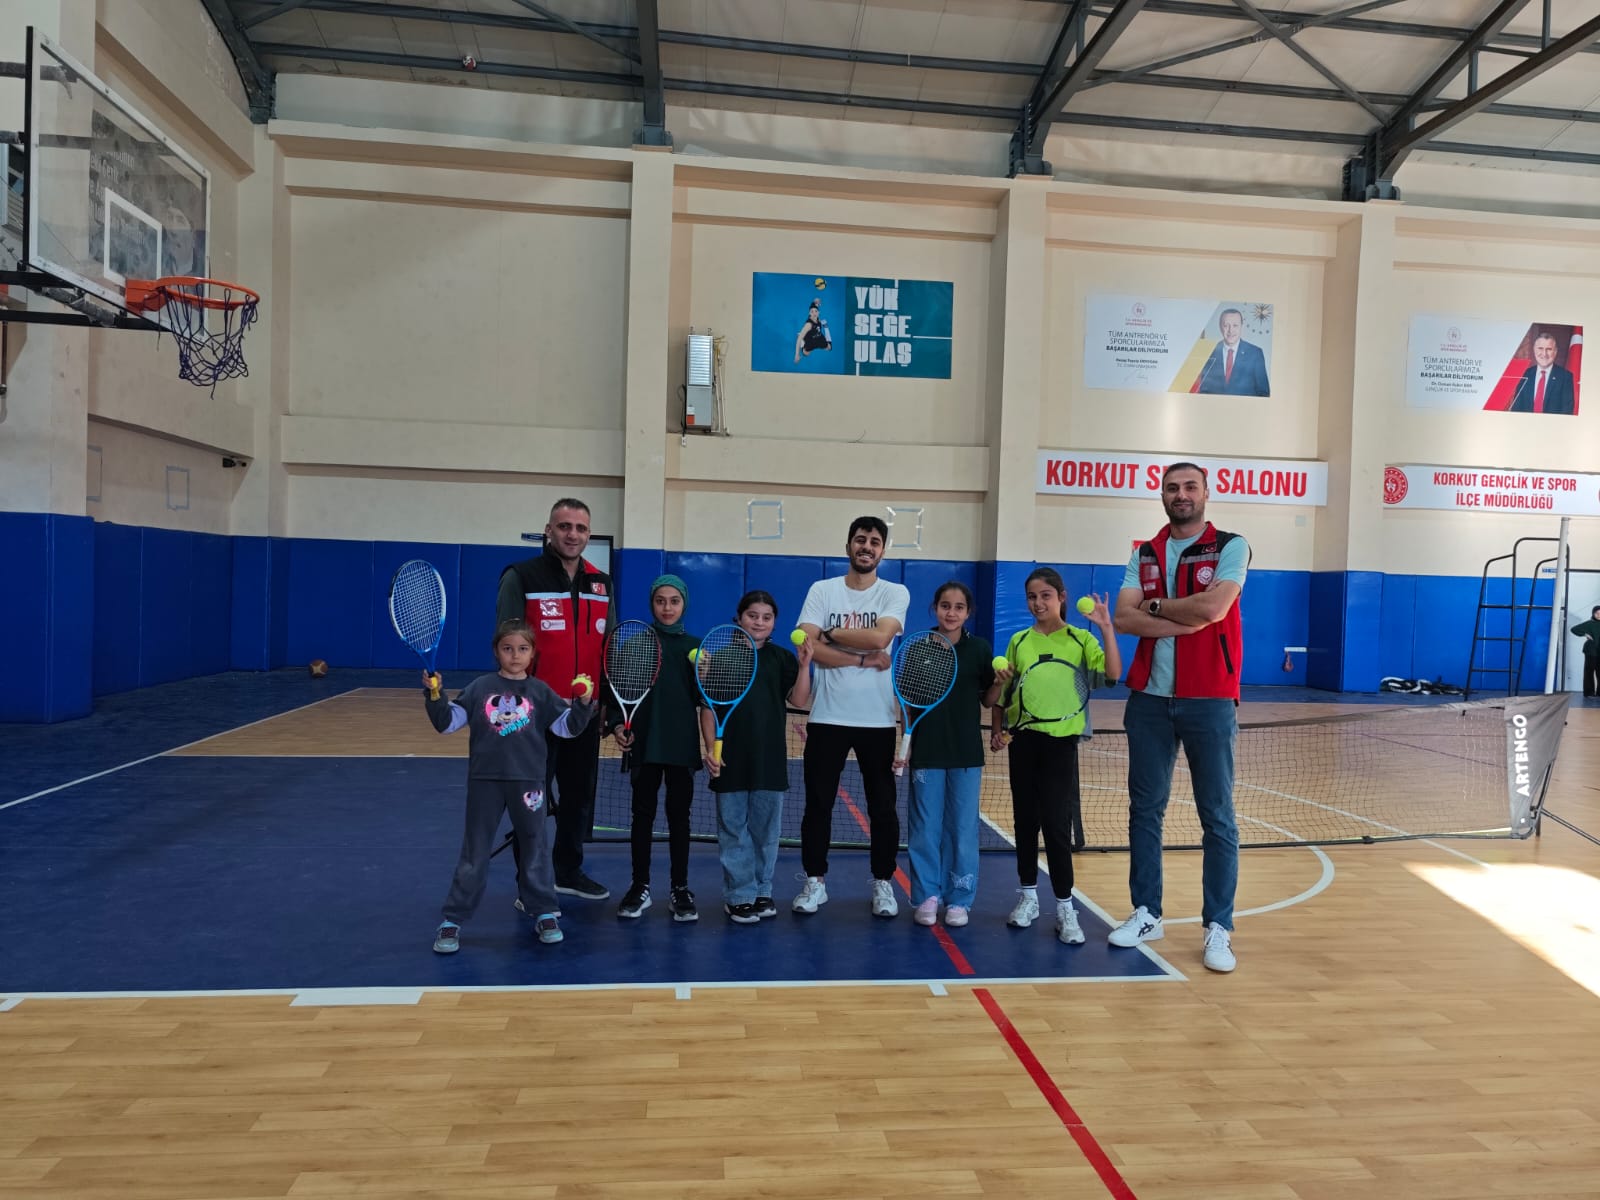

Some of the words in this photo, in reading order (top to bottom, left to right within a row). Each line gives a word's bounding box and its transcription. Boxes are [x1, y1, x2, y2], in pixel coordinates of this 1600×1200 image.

[854, 285, 898, 310] YÜK
[854, 312, 912, 338] SEĞE
[854, 340, 912, 367] ULAŞ
[1046, 459, 1139, 489] KORKUT
[1216, 468, 1307, 498] SALONU
[1433, 471, 1478, 487] KORKUT
[1481, 473, 1528, 490] GENÇLİK
[1532, 477, 1544, 490] VE
[1547, 478, 1577, 491] SPOR
[1456, 490, 1480, 507] İLÇE
[1484, 491, 1553, 510] MÜDÜRLÜĞÜ
[1512, 714, 1530, 797] ARTENGO
